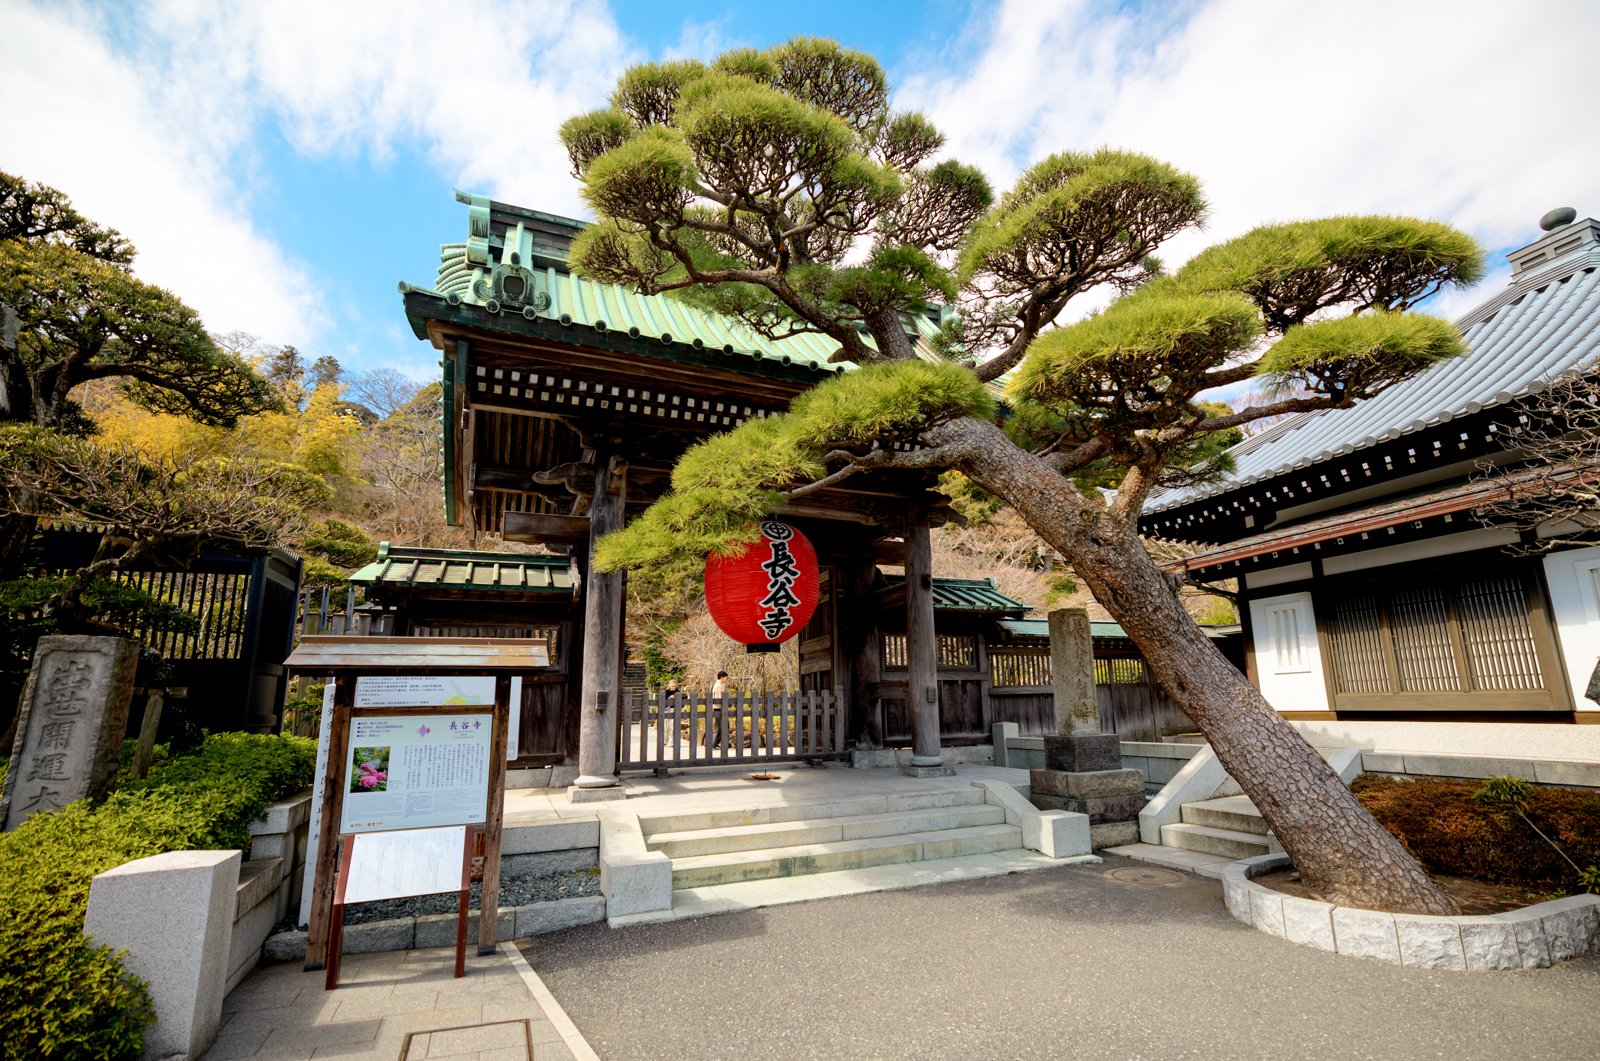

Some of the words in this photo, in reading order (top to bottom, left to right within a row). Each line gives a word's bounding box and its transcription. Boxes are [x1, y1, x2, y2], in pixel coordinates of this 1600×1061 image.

[758, 541, 801, 640] 長谷寺
[449, 720, 482, 731] 長谷寺
